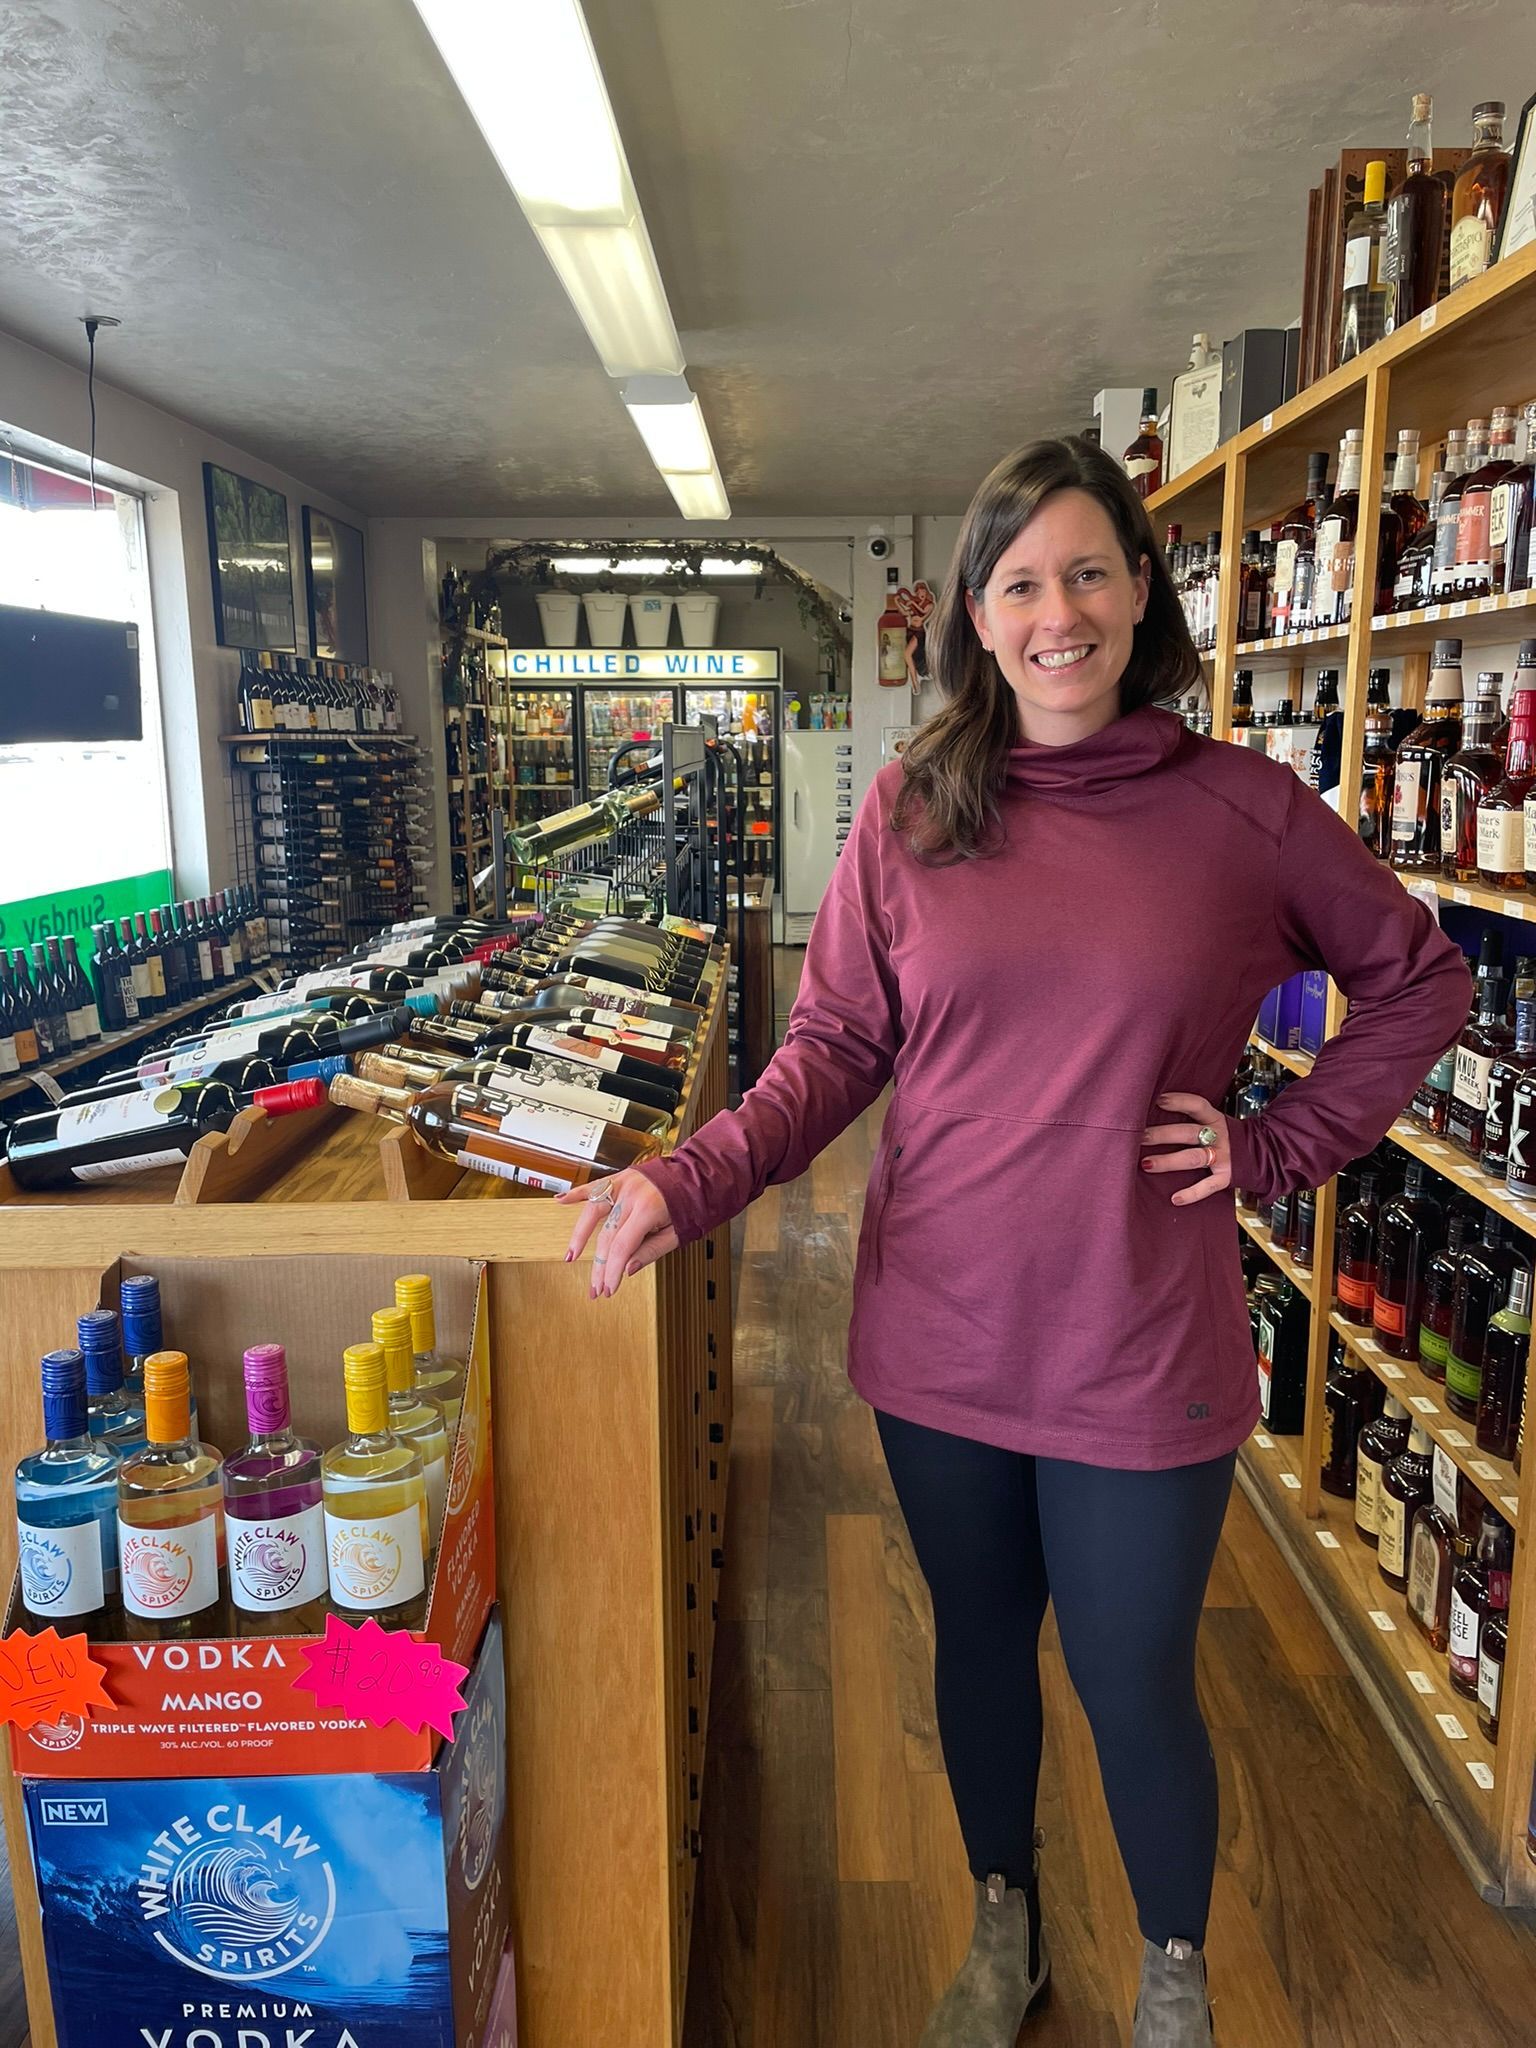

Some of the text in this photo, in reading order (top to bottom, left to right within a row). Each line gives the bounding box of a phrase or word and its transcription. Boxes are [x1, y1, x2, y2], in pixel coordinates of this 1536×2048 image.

[513, 654, 745, 674] CHILLED WINE
[1457, 1051, 1477, 1080] KNOB
[1459, 1073, 1479, 1090] CREEK
[1476, 1091, 1482, 1105] 9
[26, 1530, 66, 1558] CLAW
[123, 1535, 187, 1575] WHITE CLAW
[233, 1527, 300, 1571] WHITE CLAW
[332, 1526, 395, 1568] WHITE CLAW
[451, 1532, 479, 1595] VODKA
[27, 1579, 65, 1602] SPIRITS
[142, 1578, 187, 1605] SPIRITS
[256, 1567, 301, 1597] SPIRITS
[352, 1567, 396, 1595] SPIRITS
[132, 1643, 286, 1671] VODKA
[161, 1690, 262, 1711] MANGO
[41, 1729, 79, 1748] SPIRITS
[92, 1724, 136, 1734] TRIPLE
[139, 1723, 176, 1734] WAVE
[248, 1721, 316, 1731] FLAVORED
[319, 1719, 367, 1730] VODKA
[160, 1741, 177, 1750] 30%
[227, 1740, 239, 1749] 60
[241, 1739, 274, 1748] PROOF
[48, 1804, 103, 1821] NEW
[138, 1804, 320, 1920] WHITE CLAW
[197, 1912, 318, 1969] SPIRITS
[183, 2003, 313, 2018] PREMIUM
